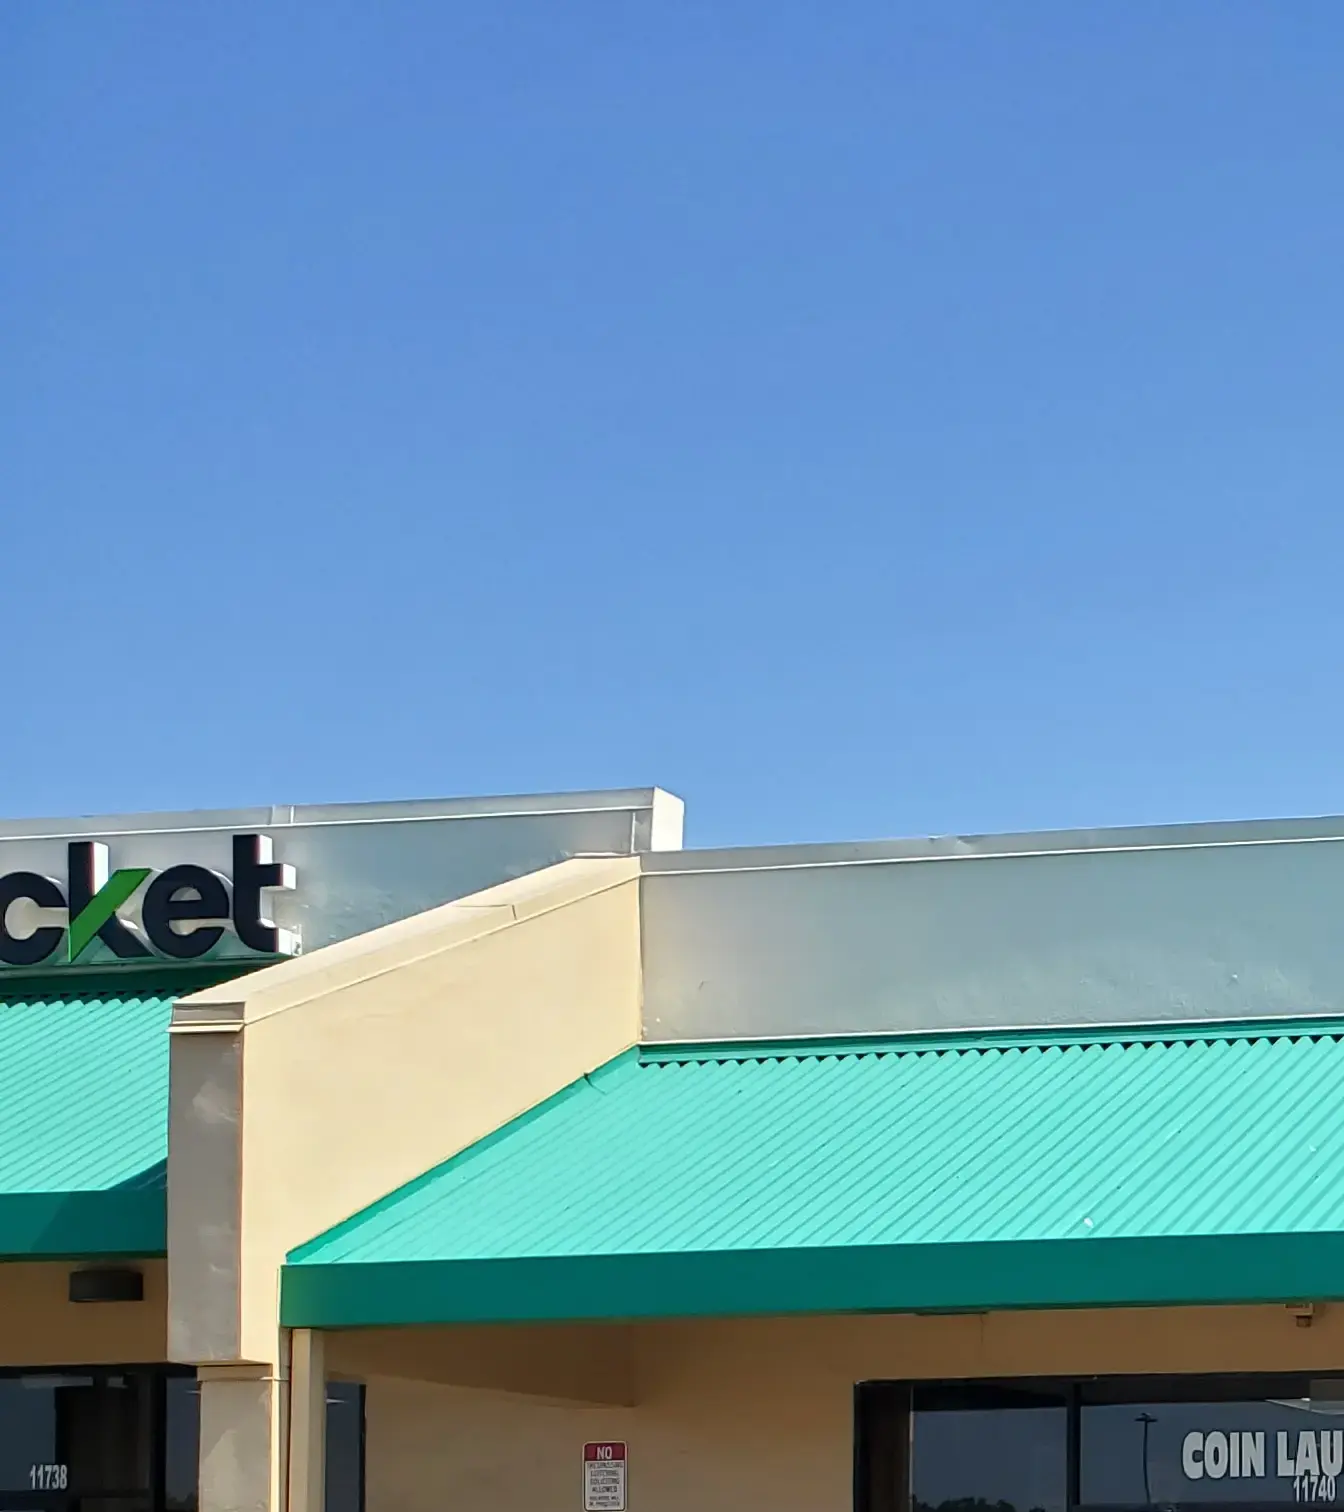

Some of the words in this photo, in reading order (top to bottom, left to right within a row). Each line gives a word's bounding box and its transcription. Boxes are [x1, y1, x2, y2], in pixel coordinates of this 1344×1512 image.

[0, 834, 297, 964] cket
[597, 1446, 612, 1459] NO
[1182, 1431, 1265, 1479] COIN
[29, 1464, 67, 1490] 11738
[1293, 1475, 1336, 1502] 11740
